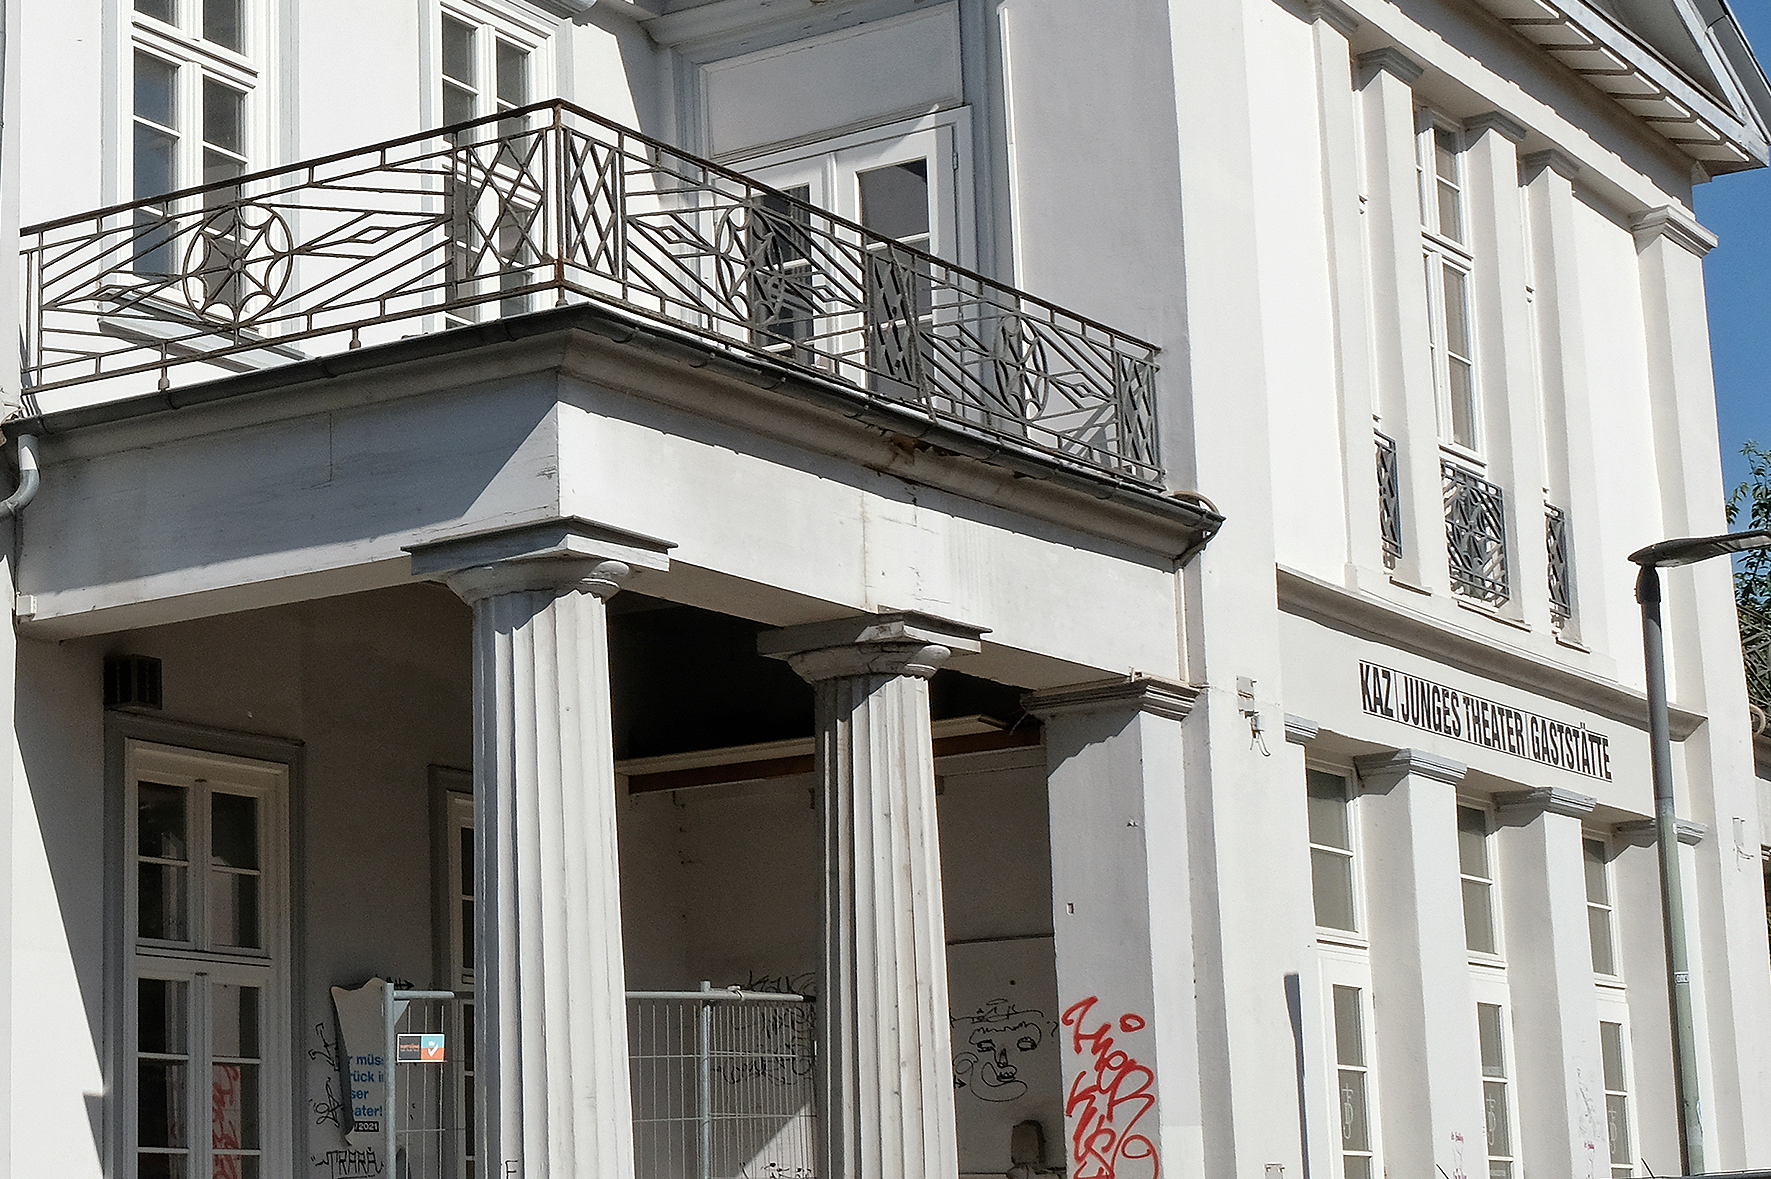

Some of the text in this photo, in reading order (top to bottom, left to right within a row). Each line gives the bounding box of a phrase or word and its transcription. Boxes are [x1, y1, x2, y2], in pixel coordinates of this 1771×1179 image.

[1359, 663, 1613, 779] KAZ JUNGES THEATER GASTSTÄTTE
[356, 1053, 384, 1066] müs
